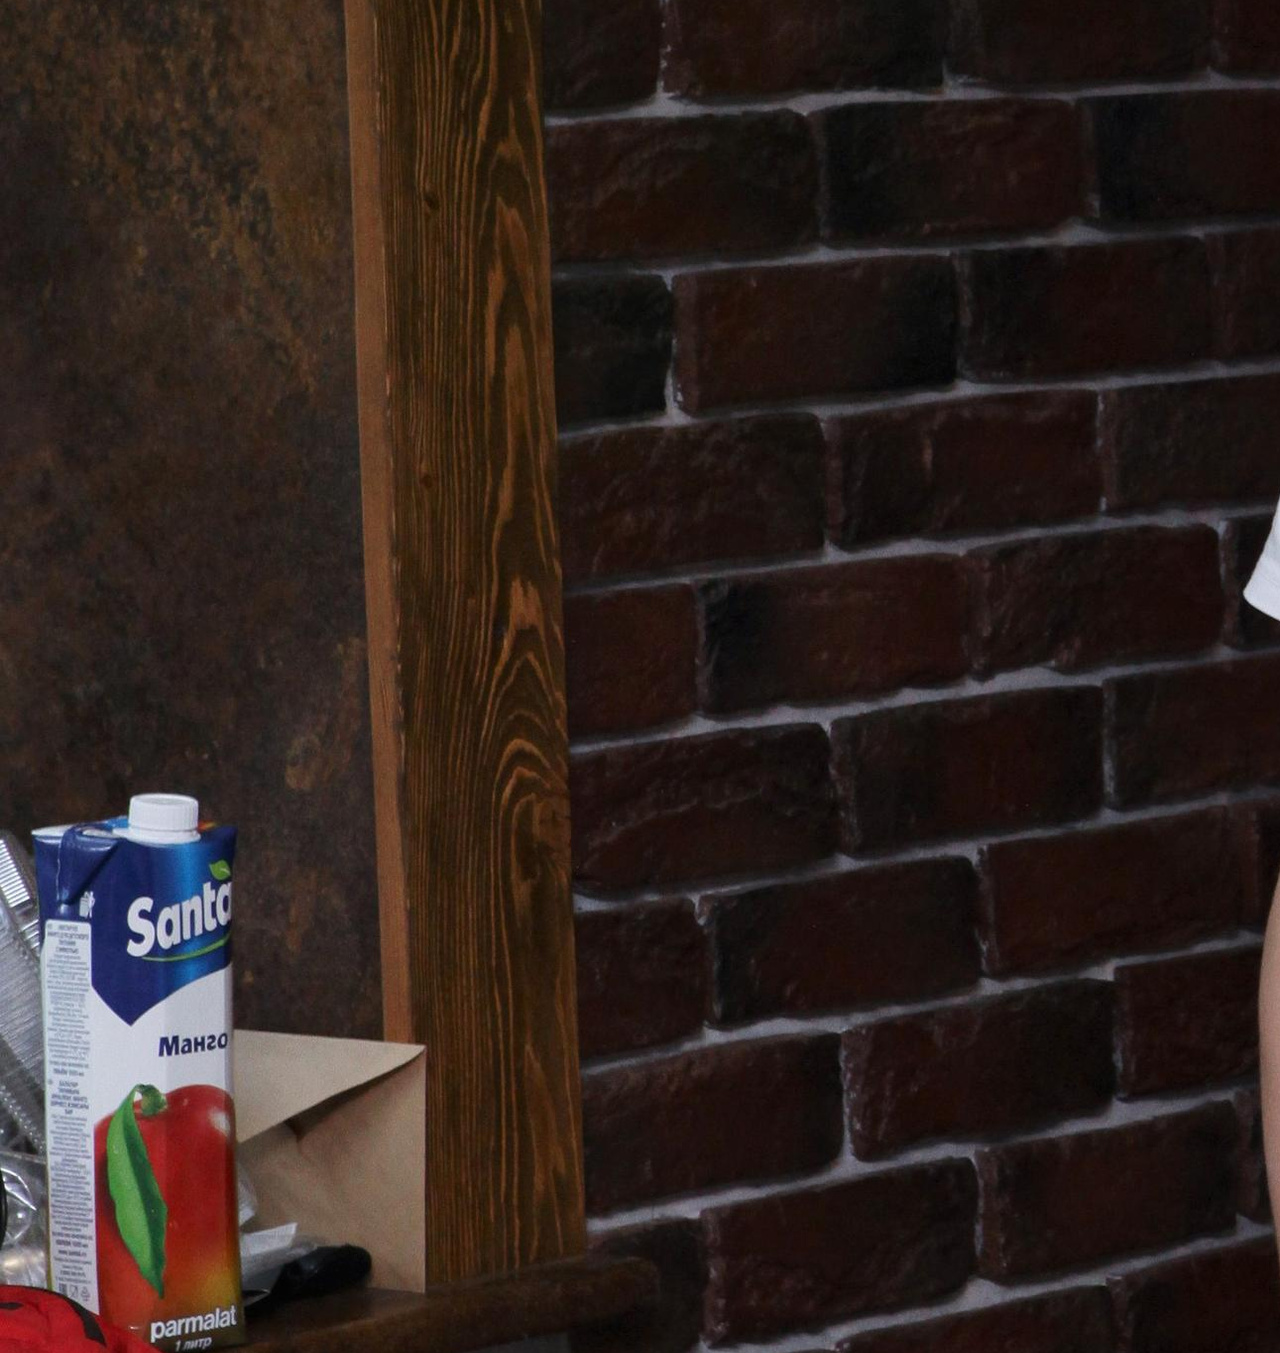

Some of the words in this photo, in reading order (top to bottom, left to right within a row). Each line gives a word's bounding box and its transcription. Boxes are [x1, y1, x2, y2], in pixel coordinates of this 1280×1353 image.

[158, 1033, 228, 1057] Манго
[151, 1305, 237, 1343] parmalat
[174, 1340, 182, 1352] 1
[183, 1337, 212, 1351] литр
